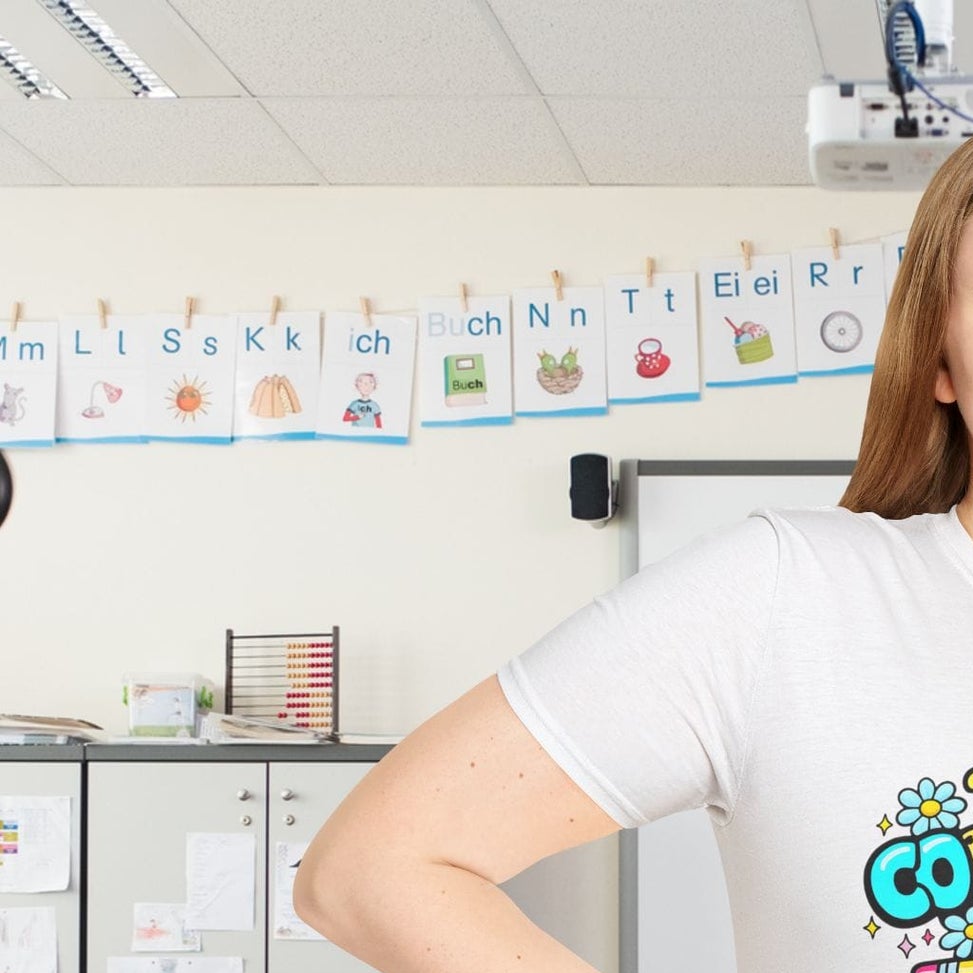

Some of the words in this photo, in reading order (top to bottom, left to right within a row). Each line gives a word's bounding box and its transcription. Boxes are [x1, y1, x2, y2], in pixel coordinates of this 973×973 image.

[714, 272, 740, 298] Ei
[753, 269, 778, 296] ei
[809, 262, 829, 288] R
[853, 265, 864, 285] r
[621, 288, 640, 314] T
[664, 288, 675, 313] t
[427, 310, 502, 337] Buch
[529, 303, 550, 328] N
[570, 307, 587, 327] n
[19, 342, 45, 361] m
[75, 329, 92, 355] L
[162, 328, 181, 354] S
[203, 336, 218, 356] s
[245, 326, 265, 352] K
[286, 326, 301, 351] k
[348, 327, 391, 355] ich
[452, 379, 483, 391] Buch
